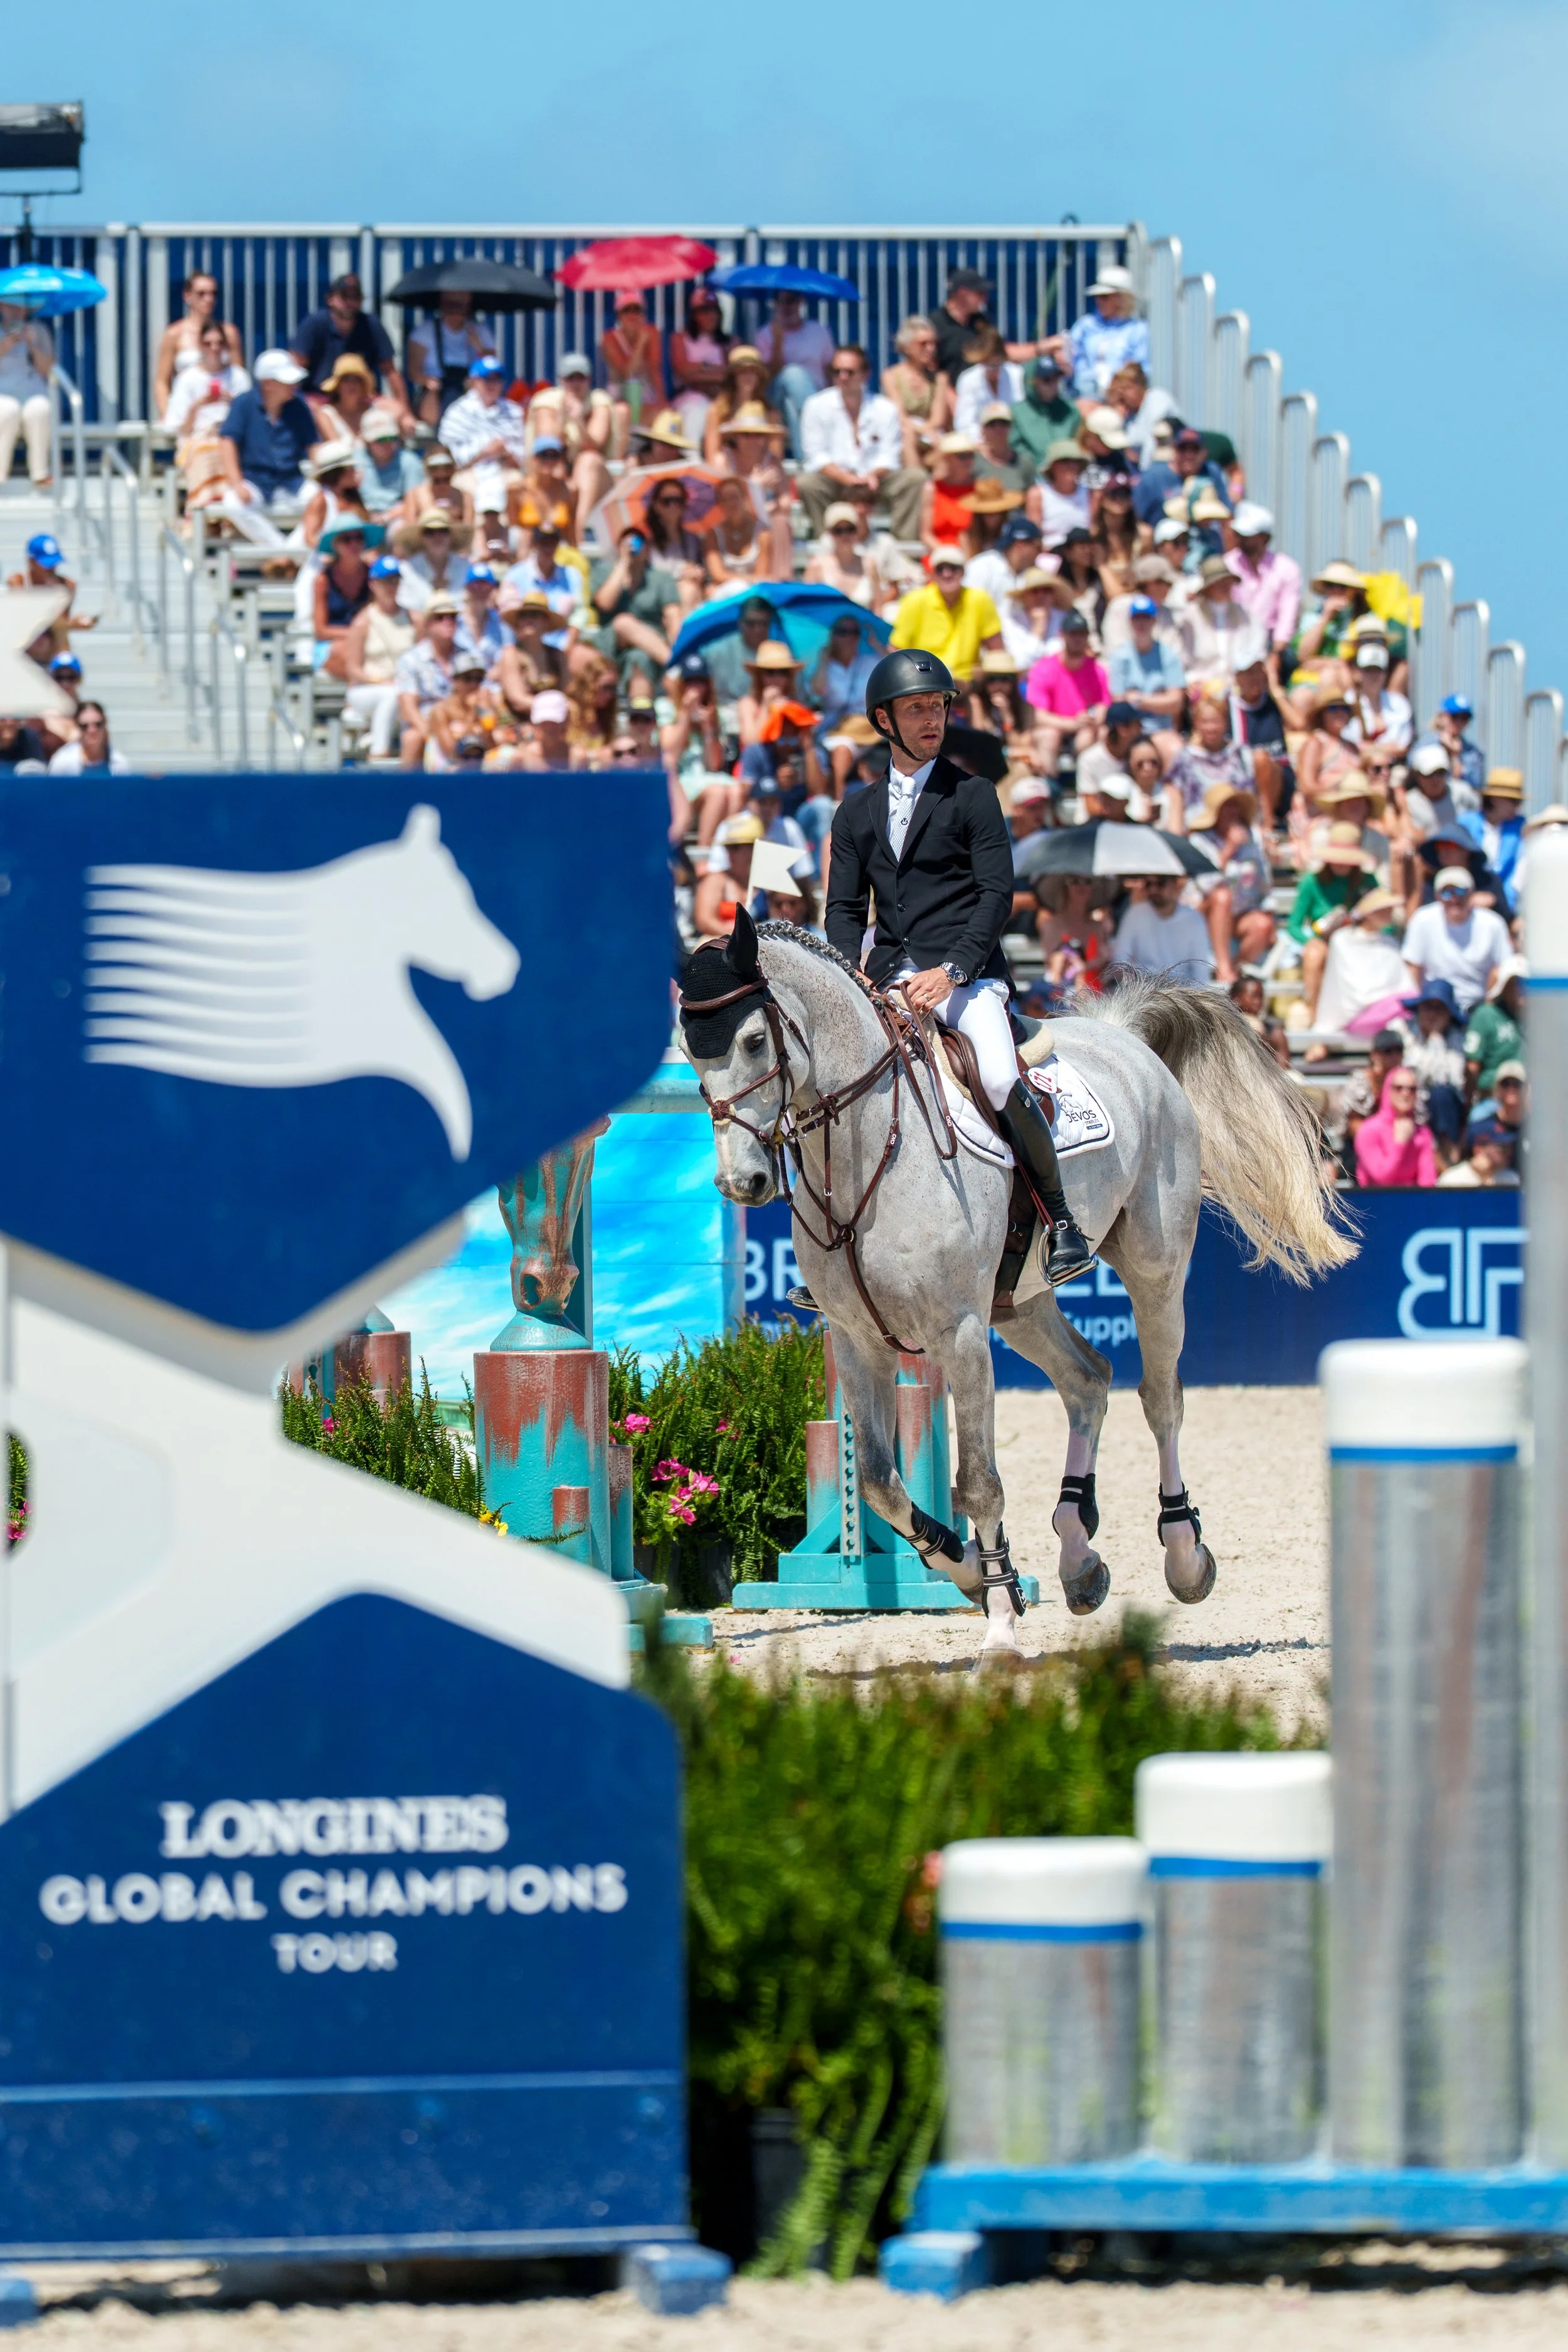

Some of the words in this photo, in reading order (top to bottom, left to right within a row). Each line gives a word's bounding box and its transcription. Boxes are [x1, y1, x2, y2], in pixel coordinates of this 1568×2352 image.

[1034, 1071, 1052, 1092] 171
[161, 1794, 509, 1858] LONGINES
[40, 1873, 267, 1924] GLOBAL
[280, 1863, 628, 1919] CHAMPIONS
[273, 1931, 398, 1973] TOUR
